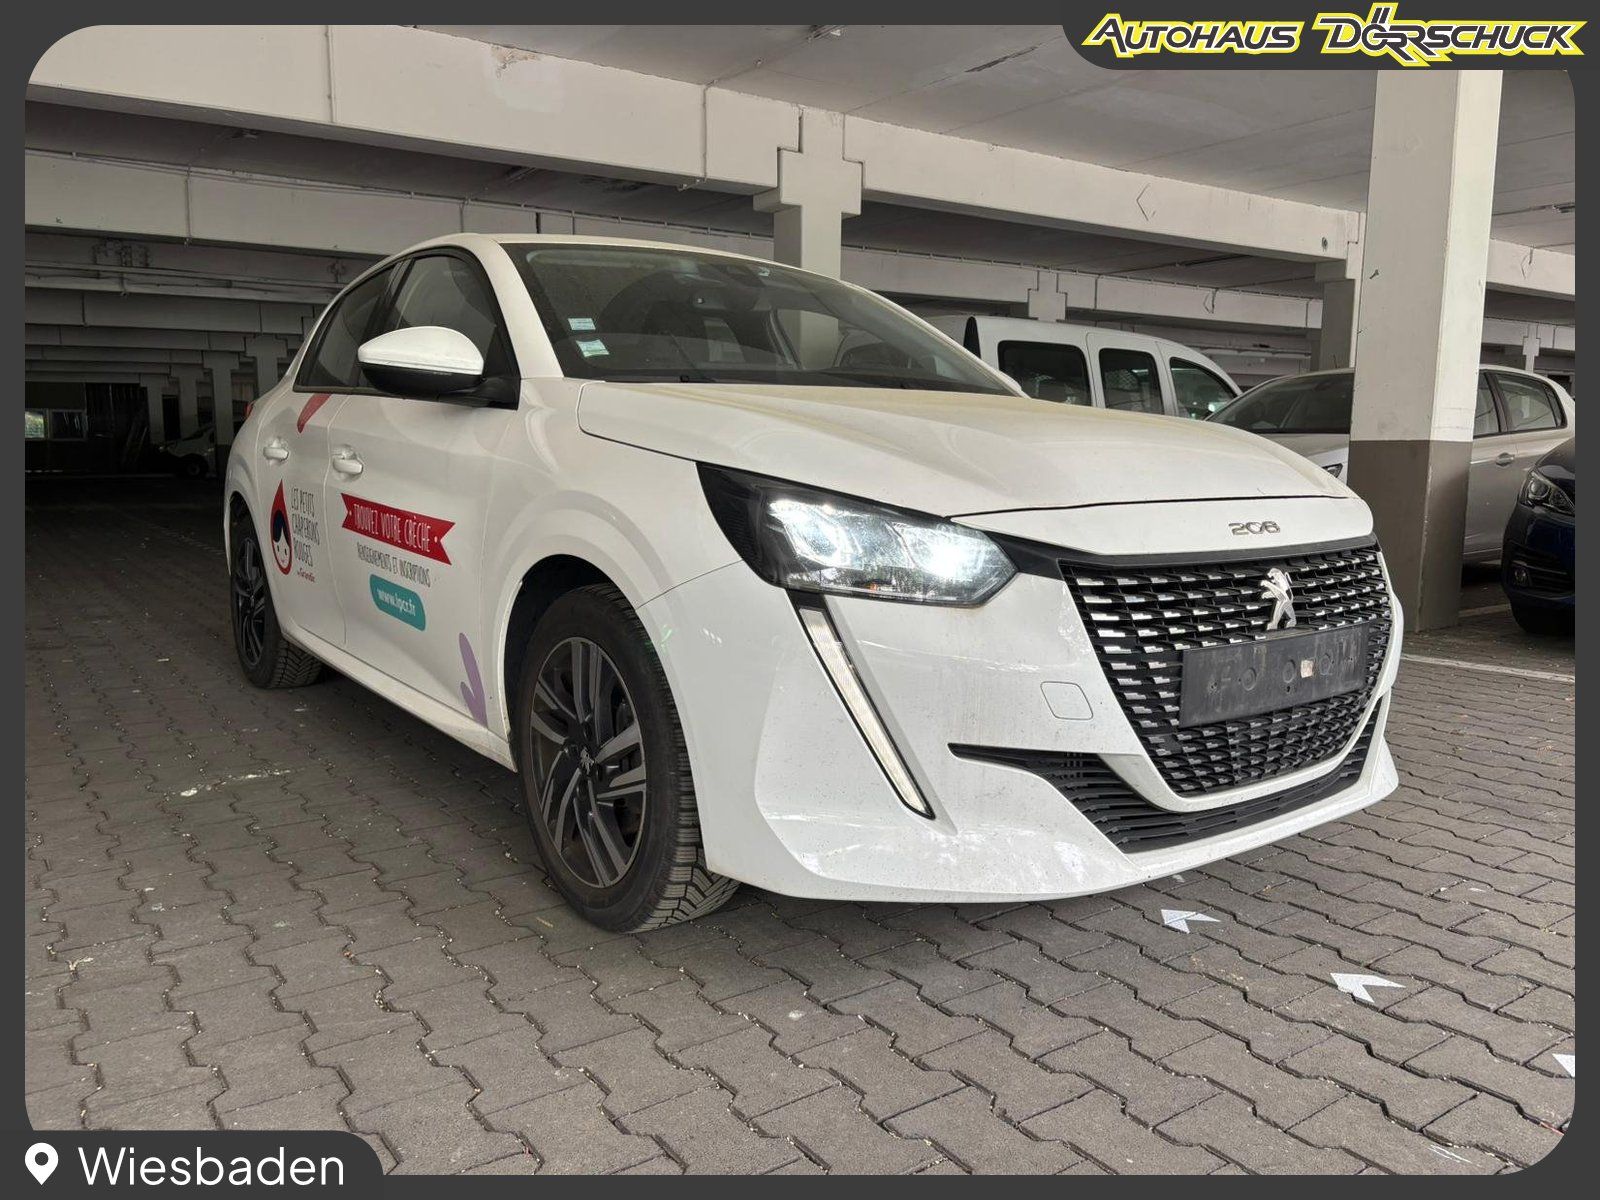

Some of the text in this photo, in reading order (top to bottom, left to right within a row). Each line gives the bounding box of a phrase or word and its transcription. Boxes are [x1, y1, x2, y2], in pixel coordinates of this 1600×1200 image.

[291, 487, 315, 518] LES PETITS
[353, 503, 432, 553] TROUVEZ VOTRE CRÈCHE
[293, 537, 314, 567] ROUGES
